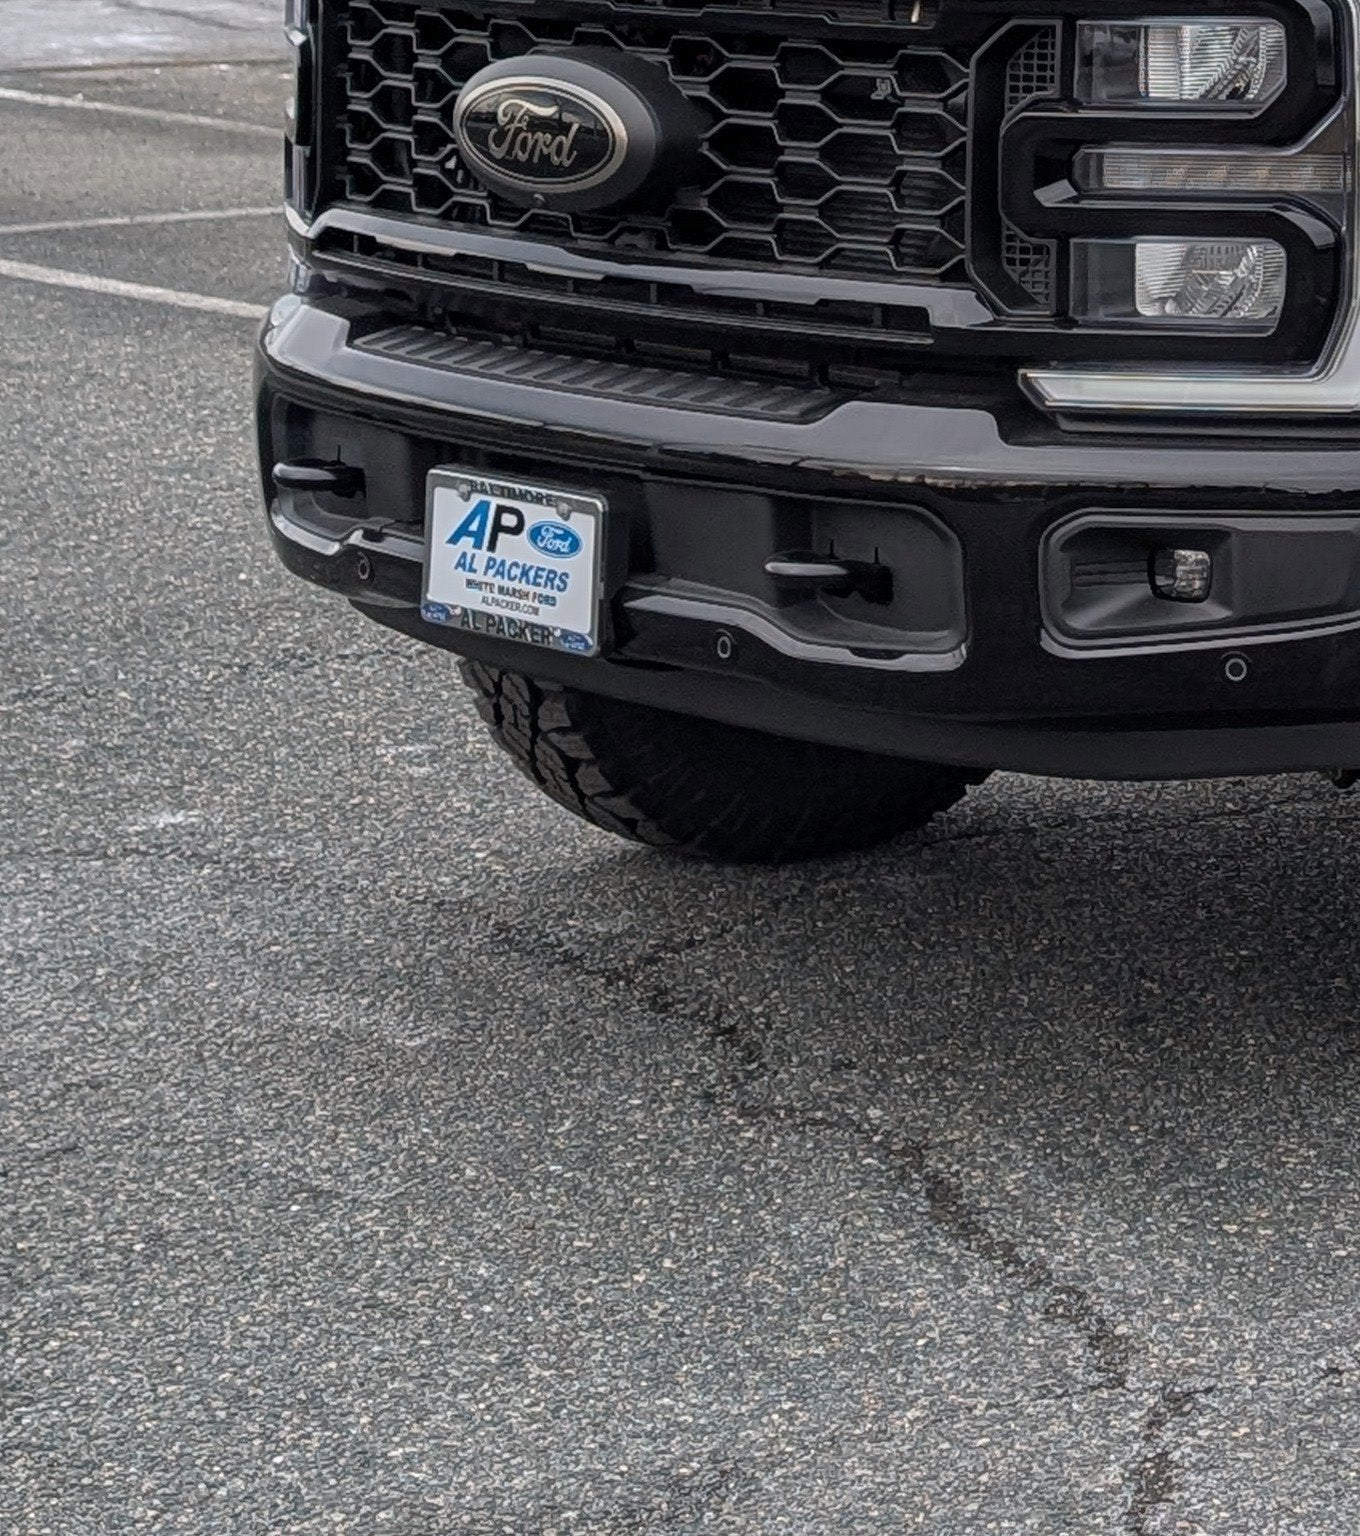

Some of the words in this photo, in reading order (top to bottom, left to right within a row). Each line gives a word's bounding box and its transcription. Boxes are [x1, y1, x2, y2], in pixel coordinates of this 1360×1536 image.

[487, 97, 578, 168] Ford
[445, 499, 525, 554] AP
[537, 525, 573, 554] Ford
[454, 551, 478, 574] AL
[483, 556, 570, 593] PACKERS
[465, 578, 495, 594] WHITE
[497, 585, 530, 602] MARSH
[531, 591, 557, 607] FORD
[460, 608, 482, 631] AL
